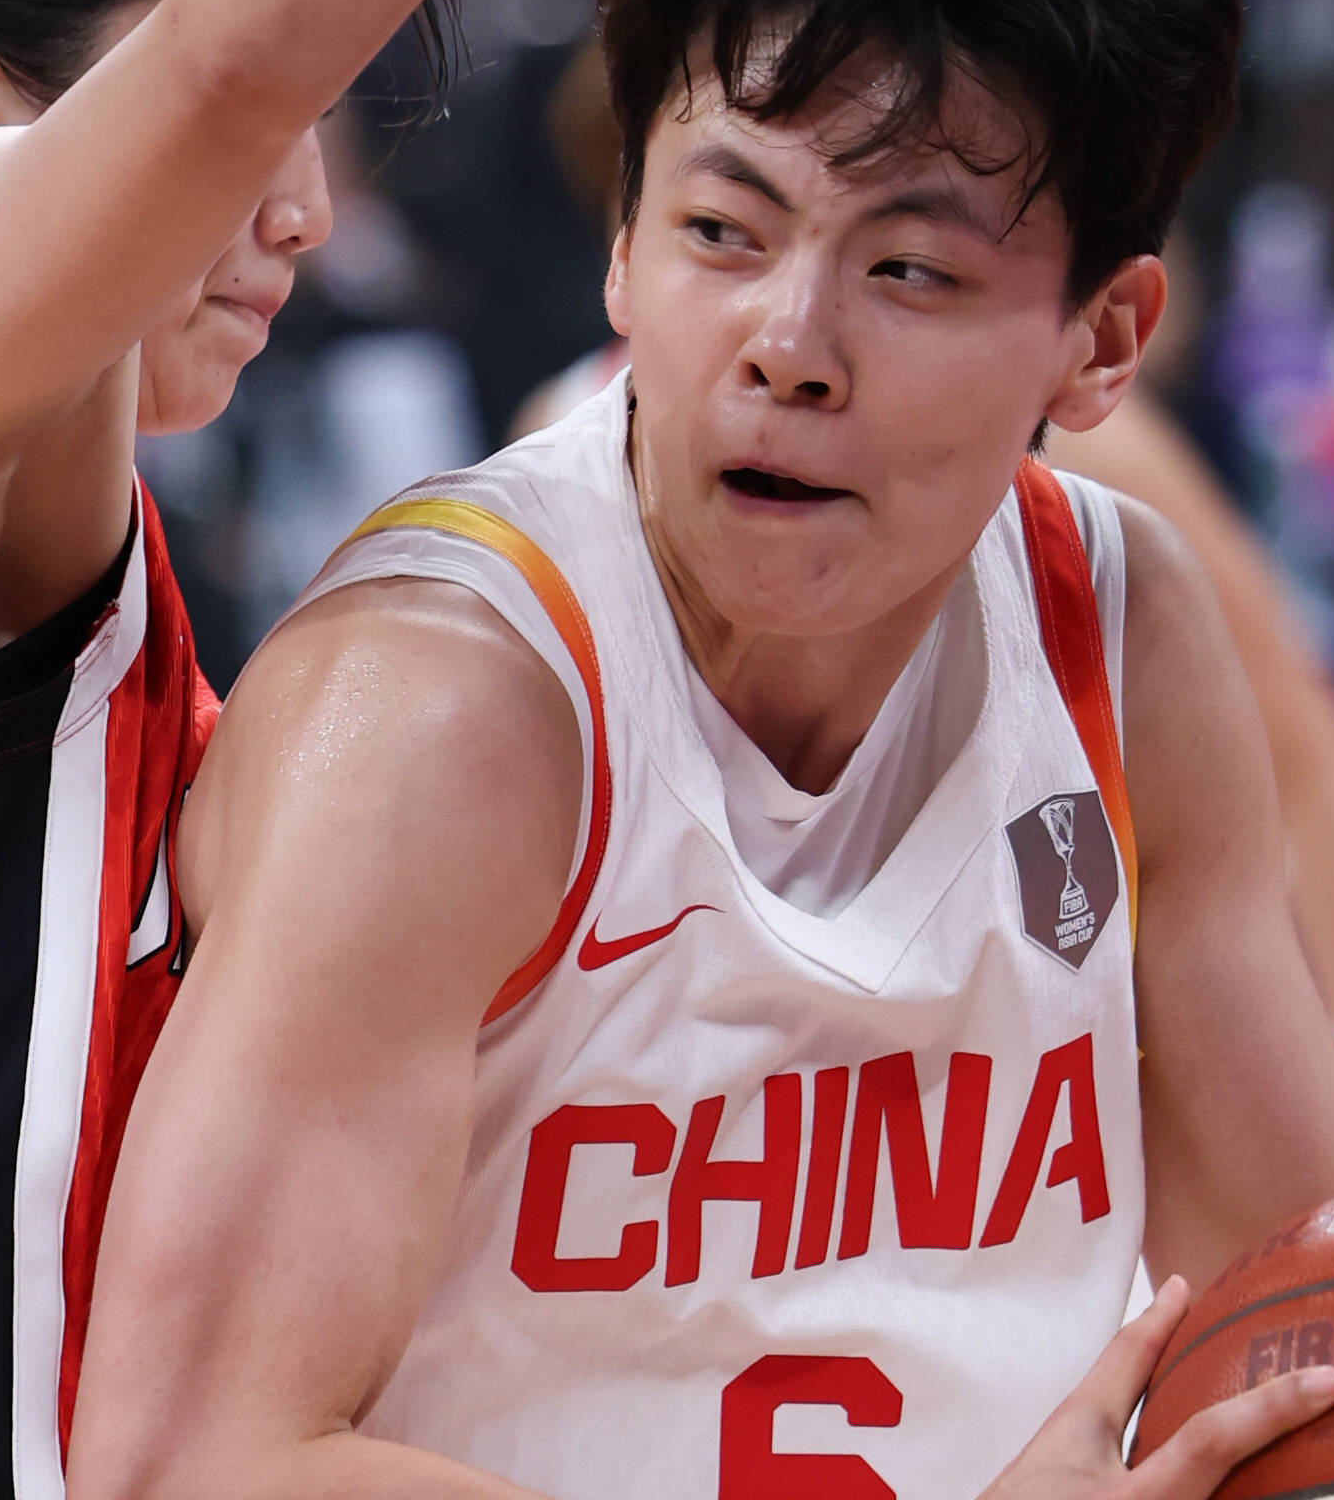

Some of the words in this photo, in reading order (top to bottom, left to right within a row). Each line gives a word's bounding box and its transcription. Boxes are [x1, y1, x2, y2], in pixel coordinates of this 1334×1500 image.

[1064, 896, 1083, 912] FIBA
[1056, 912, 1095, 937] WOMEN'S
[1060, 934, 1077, 950] ASIA
[1079, 927, 1094, 943] CUP
[511, 1033, 1111, 1293] CHINA
